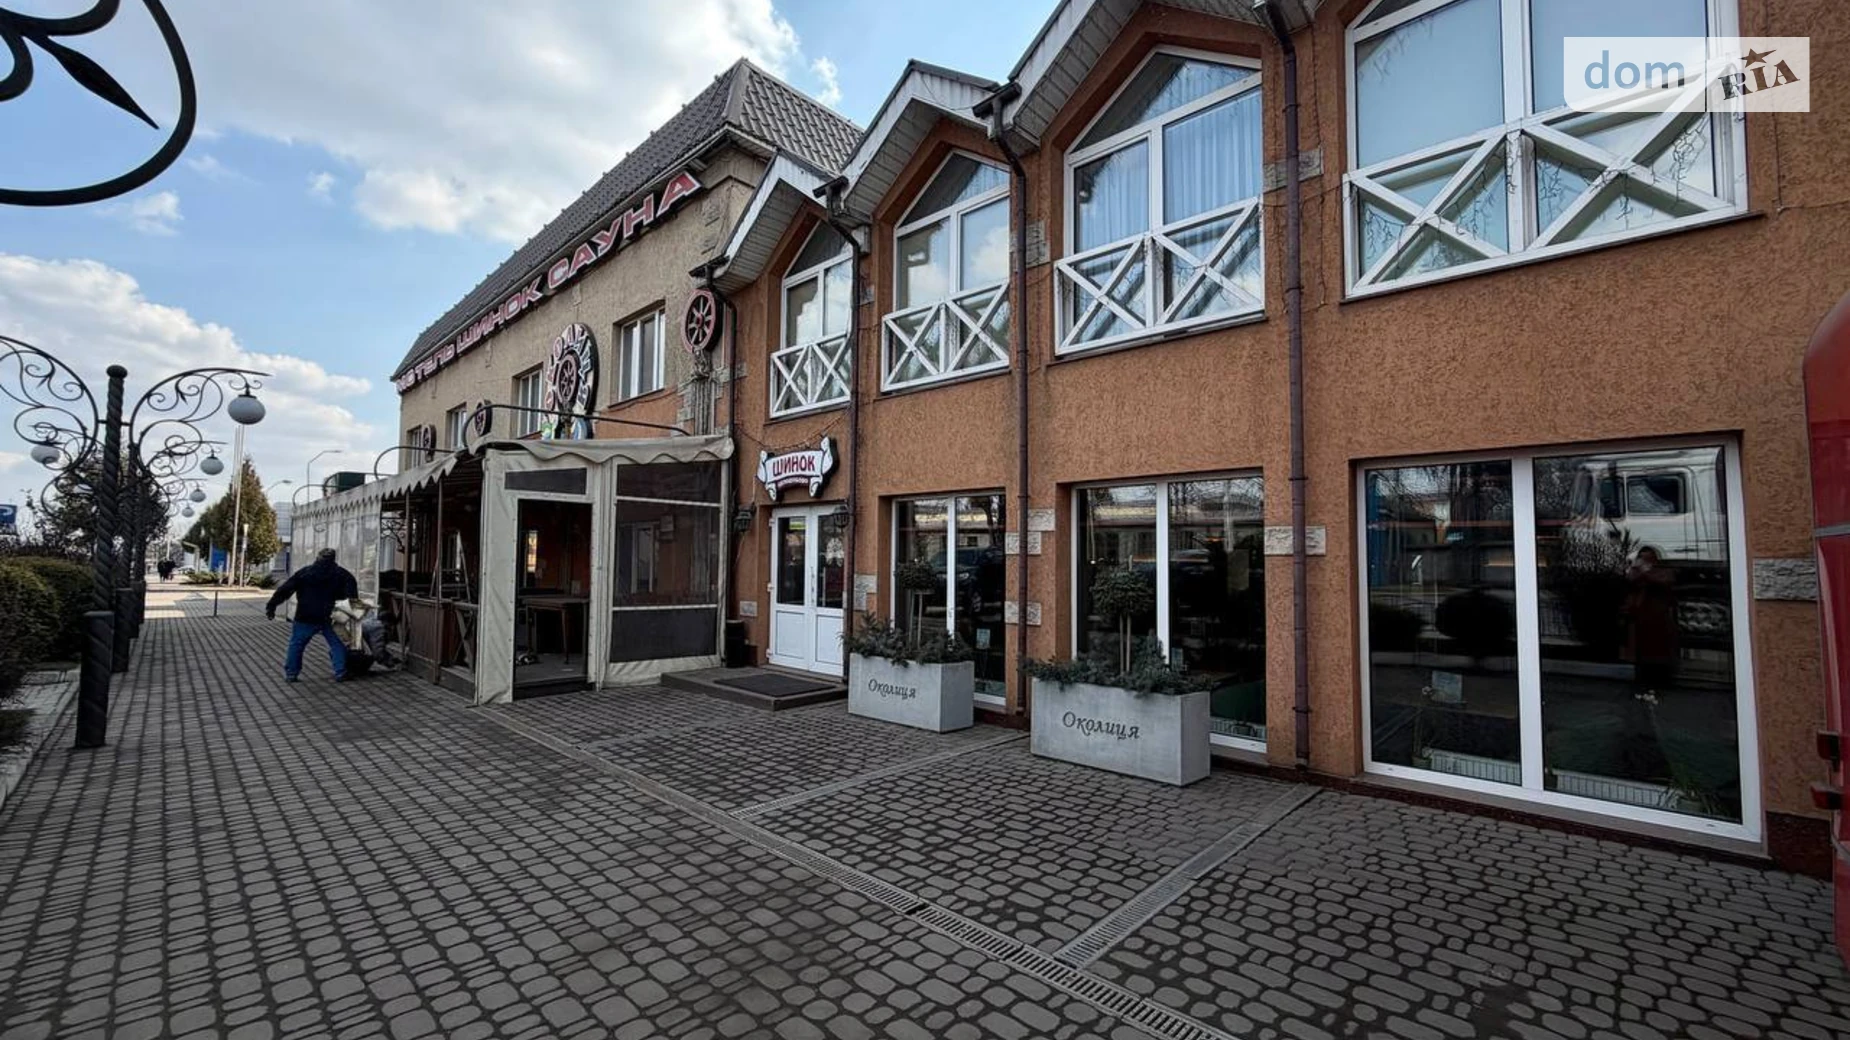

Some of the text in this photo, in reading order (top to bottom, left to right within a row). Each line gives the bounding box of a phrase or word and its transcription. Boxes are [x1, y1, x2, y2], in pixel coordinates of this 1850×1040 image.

[456, 275, 543, 354] ШИНОК
[547, 171, 701, 290] САУНА
[772, 455, 816, 477] ШИНОК
[868, 678, 916, 700] Околиця
[1062, 710, 1140, 741] Околиця
